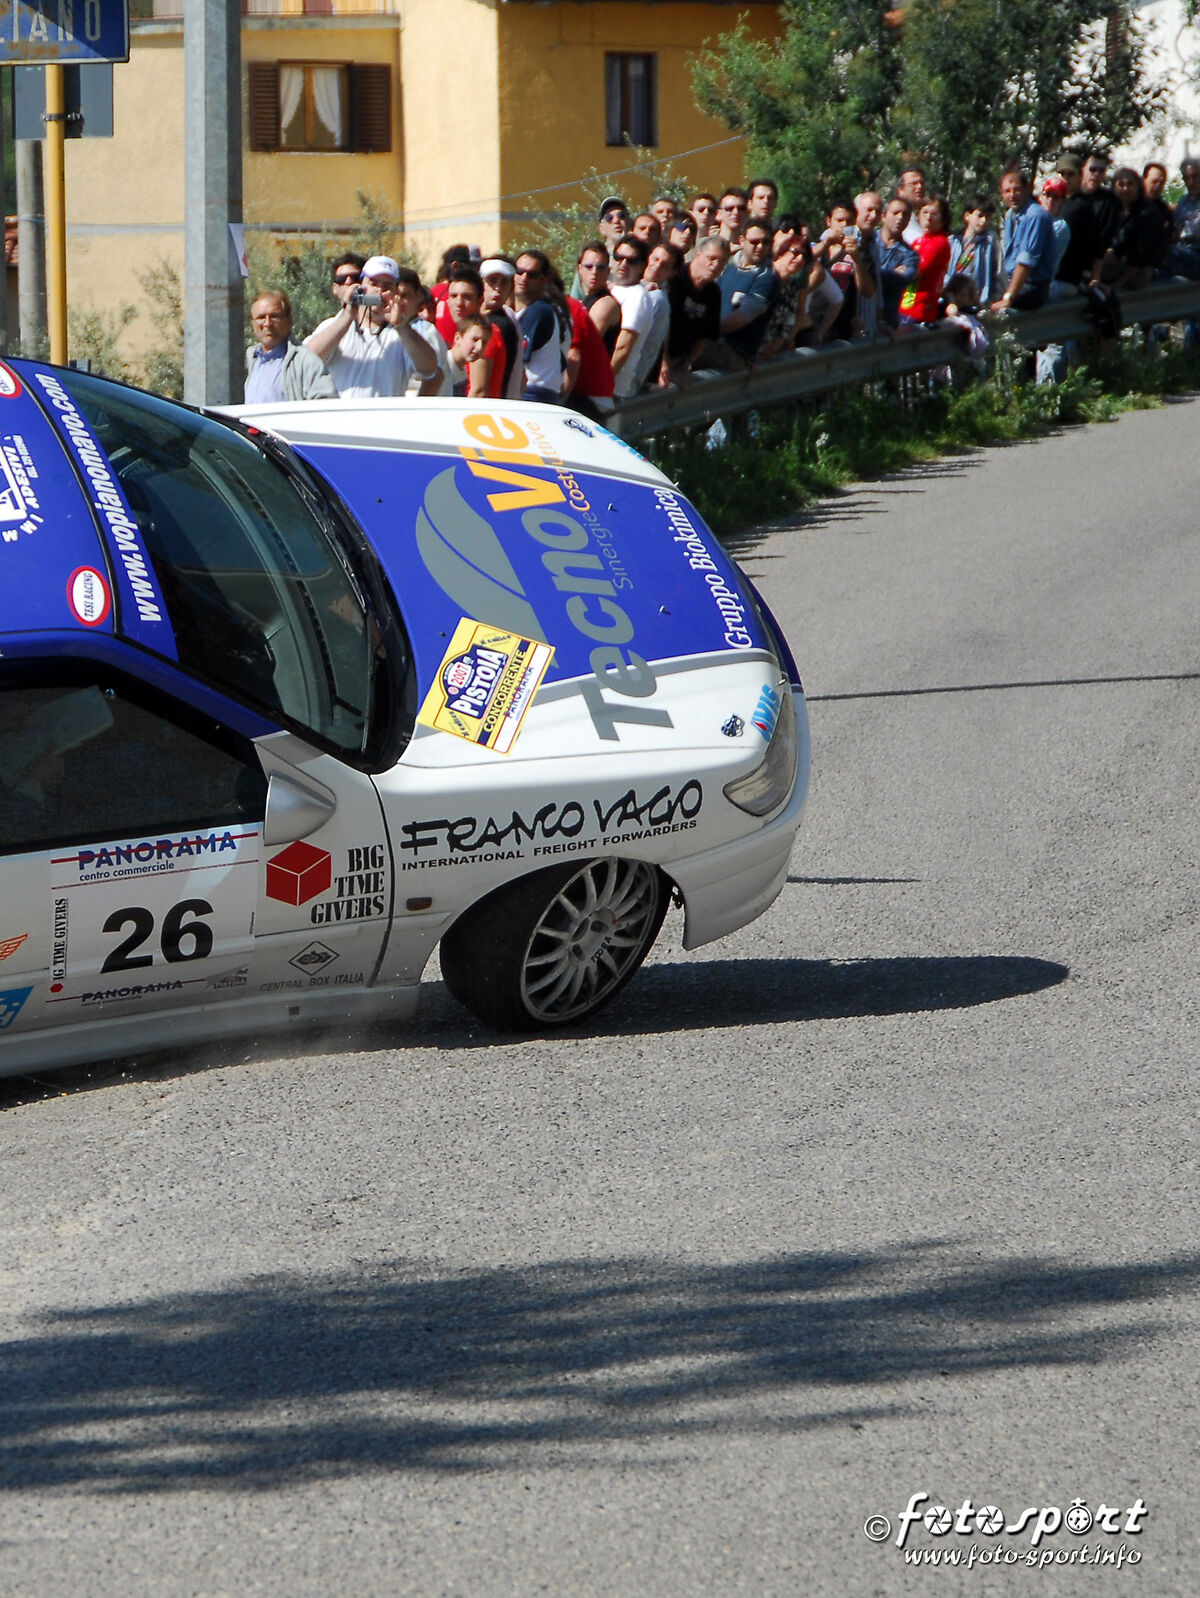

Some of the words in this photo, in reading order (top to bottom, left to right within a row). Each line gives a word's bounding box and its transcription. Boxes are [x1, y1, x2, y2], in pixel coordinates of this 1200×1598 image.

[2, 445, 40, 509] ADESIVI
[35, 373, 162, 621] www.vopianomavo.com
[653, 489, 719, 572] Biokimica
[83, 572, 94, 600] RACING
[83, 600, 94, 617] TESI
[704, 573, 753, 649] Gruppo
[450, 664, 470, 685] 2007
[450, 648, 506, 717] PISTOIA
[483, 650, 527, 732] CONCORRENTE
[503, 666, 535, 719] PANORAMA
[400, 801, 585, 855] FRANCO
[593, 778, 703, 834] VAGO
[78, 831, 237, 871] PANORAMA
[347, 844, 384, 873] BIG
[402, 850, 525, 870] INTERNATIONAL
[533, 838, 598, 857] FREIGHT
[602, 819, 698, 846] FORWARDERS
[79, 869, 110, 882] centro
[113, 859, 175, 877] commerciale
[334, 871, 385, 898] TIME
[54, 898, 67, 938] GIVERS
[310, 895, 384, 924] GIVERS
[53, 941, 65, 966] TIME
[100, 898, 215, 974] 26
[81, 980, 184, 1002] PANORAMA
[259, 980, 303, 993] CENTRAL
[309, 975, 331, 987] BOX
[334, 972, 365, 985] ITALIA
